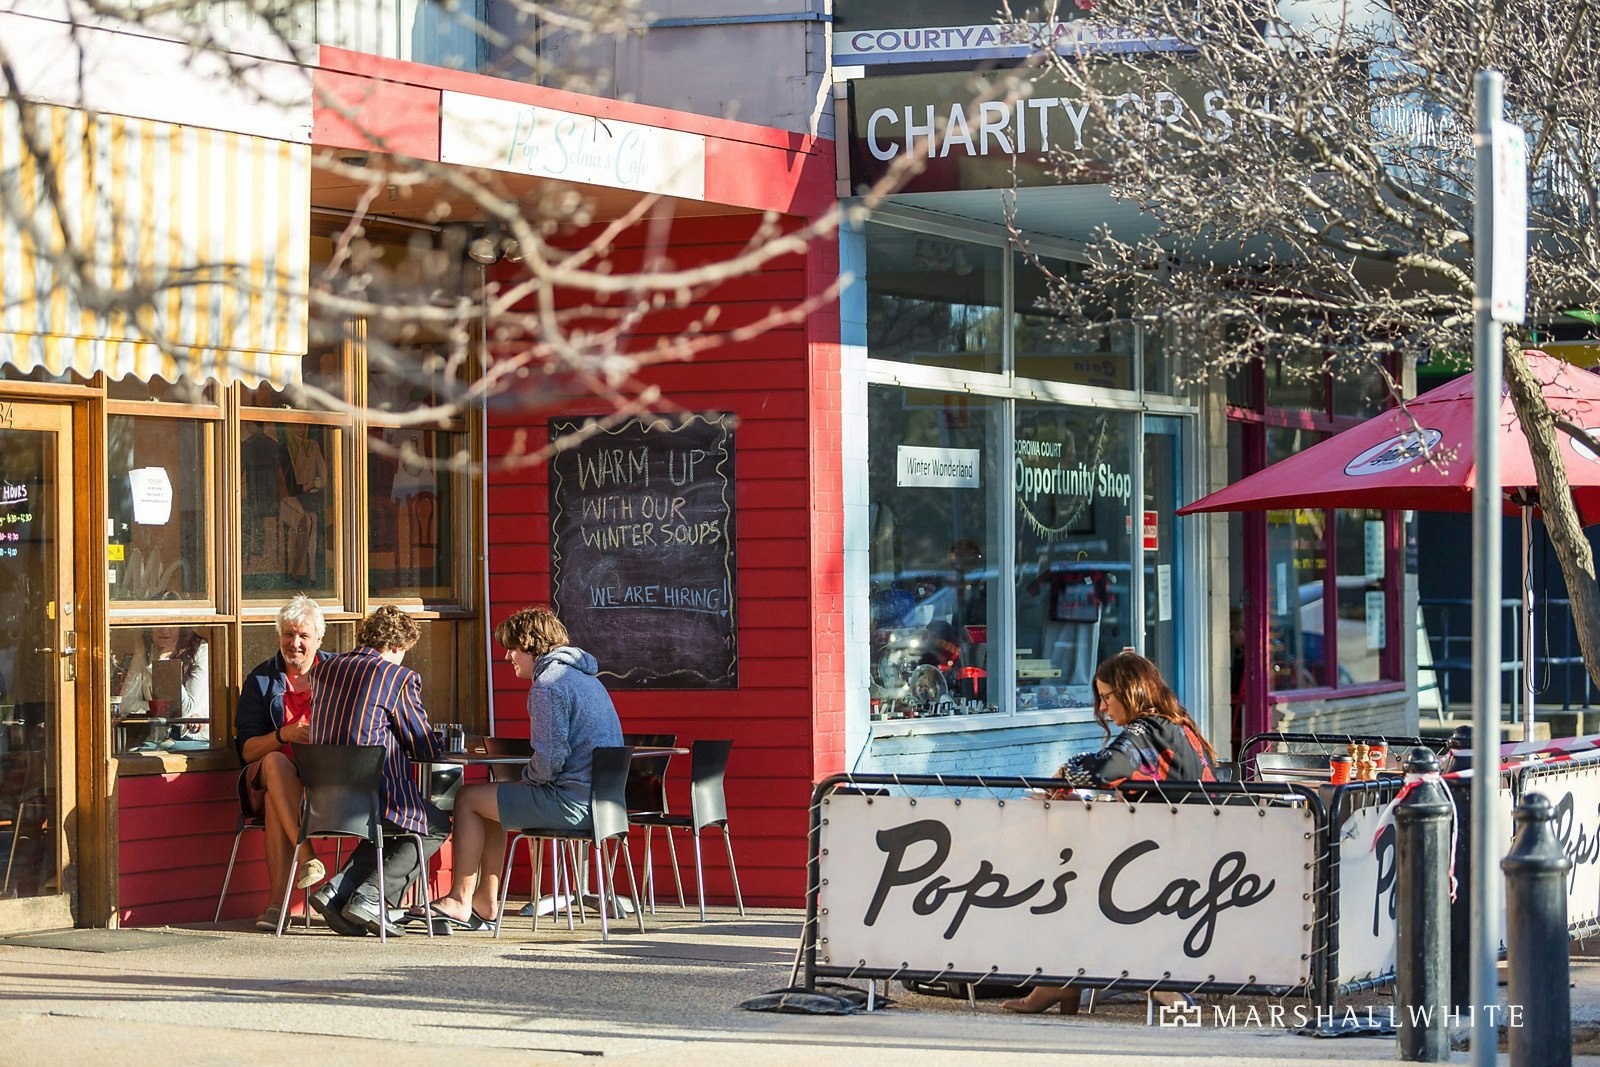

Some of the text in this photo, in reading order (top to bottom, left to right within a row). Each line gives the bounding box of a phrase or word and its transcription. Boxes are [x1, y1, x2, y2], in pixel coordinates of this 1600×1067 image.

[866, 97, 1089, 161] CHARITY
[577, 447, 705, 490] WARM UP
[906, 457, 973, 478] Winter Wonderland
[1041, 442, 1062, 457] COURT
[1015, 457, 1132, 506] Opportunity Shop
[582, 496, 688, 524] WITH OUR
[581, 520, 722, 550] WINTER SOUPS
[590, 577, 728, 617] WE ARE HIRING!
[863, 819, 1276, 958] Pop's Cafe
